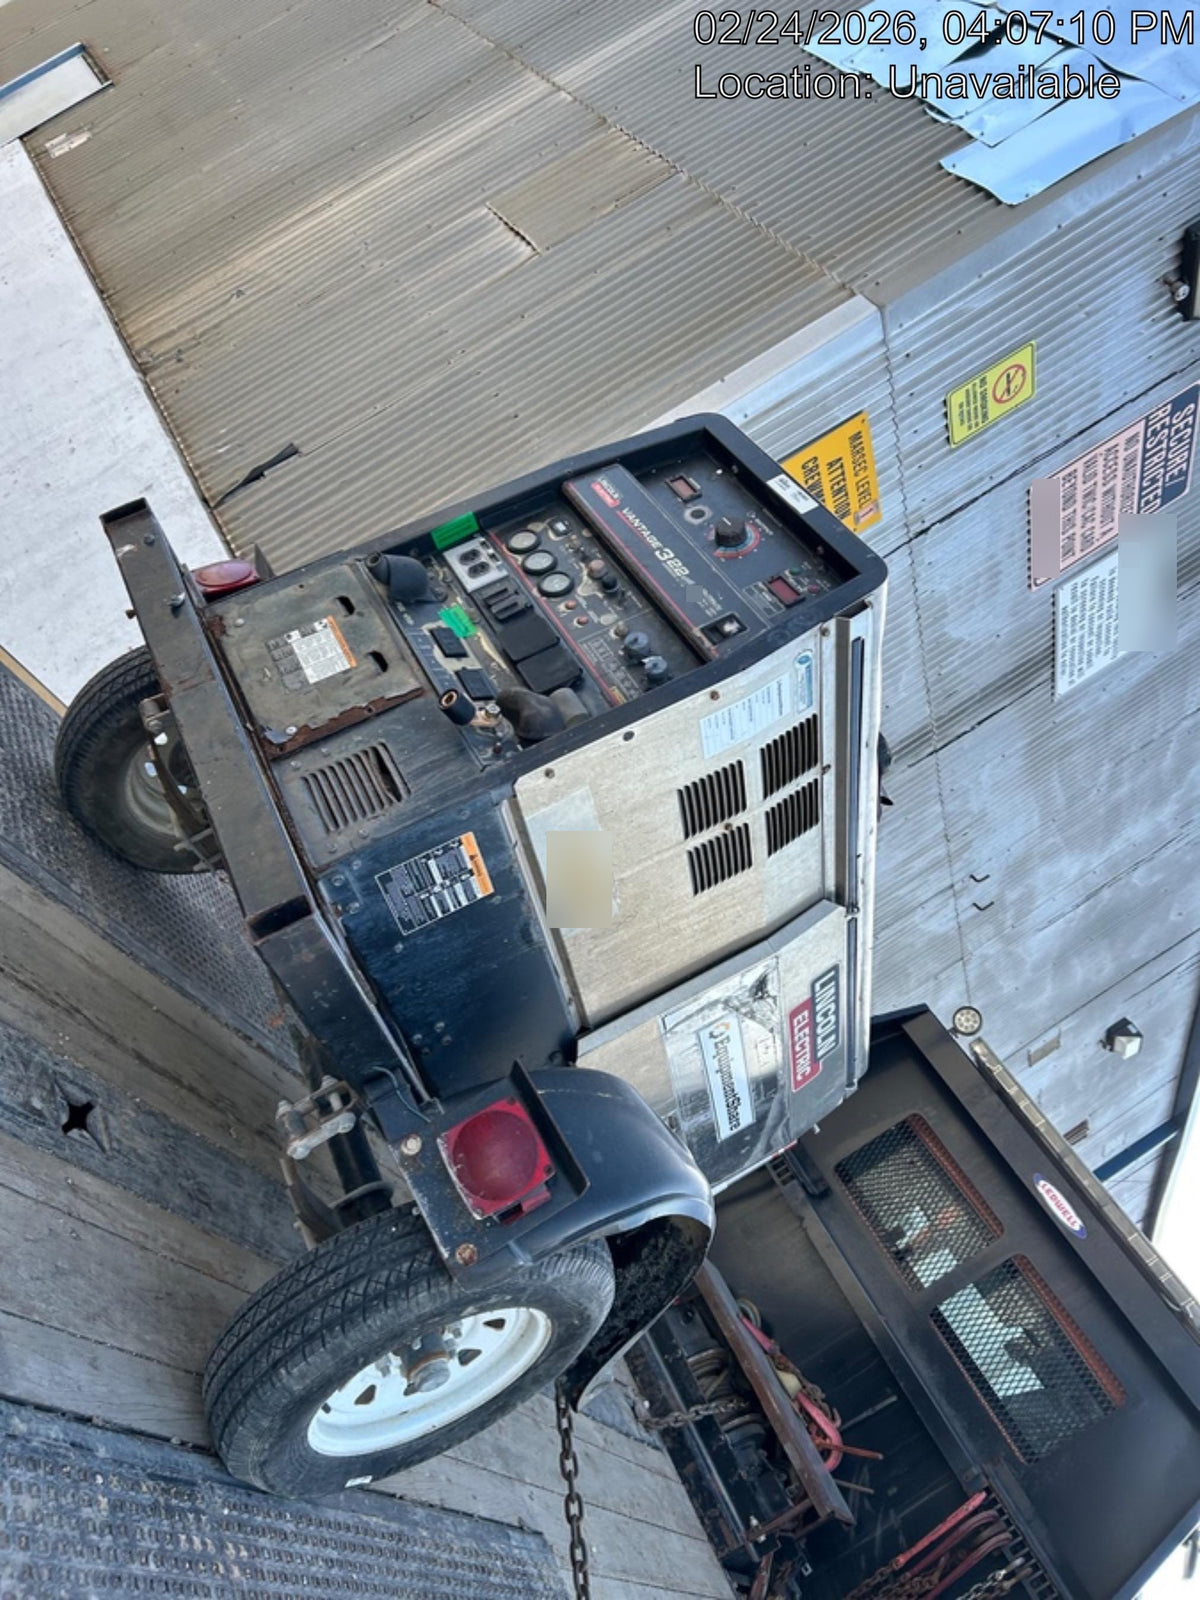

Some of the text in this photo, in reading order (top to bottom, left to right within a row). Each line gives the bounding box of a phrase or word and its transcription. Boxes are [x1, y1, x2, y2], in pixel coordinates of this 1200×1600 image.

[826, 456, 851, 520] ATTENTION
[848, 431, 868, 477] MARSEC
[1140, 405, 1171, 514] RESTRICTED
[855, 475, 872, 509] LEVEL
[621, 507, 662, 549] VANTAGE
[656, 546, 690, 577] 322
[792, 1010, 811, 1081] ELECTRIC
[814, 969, 836, 1059] LINCOLN
[712, 1033, 742, 1131] EquipmentShare
